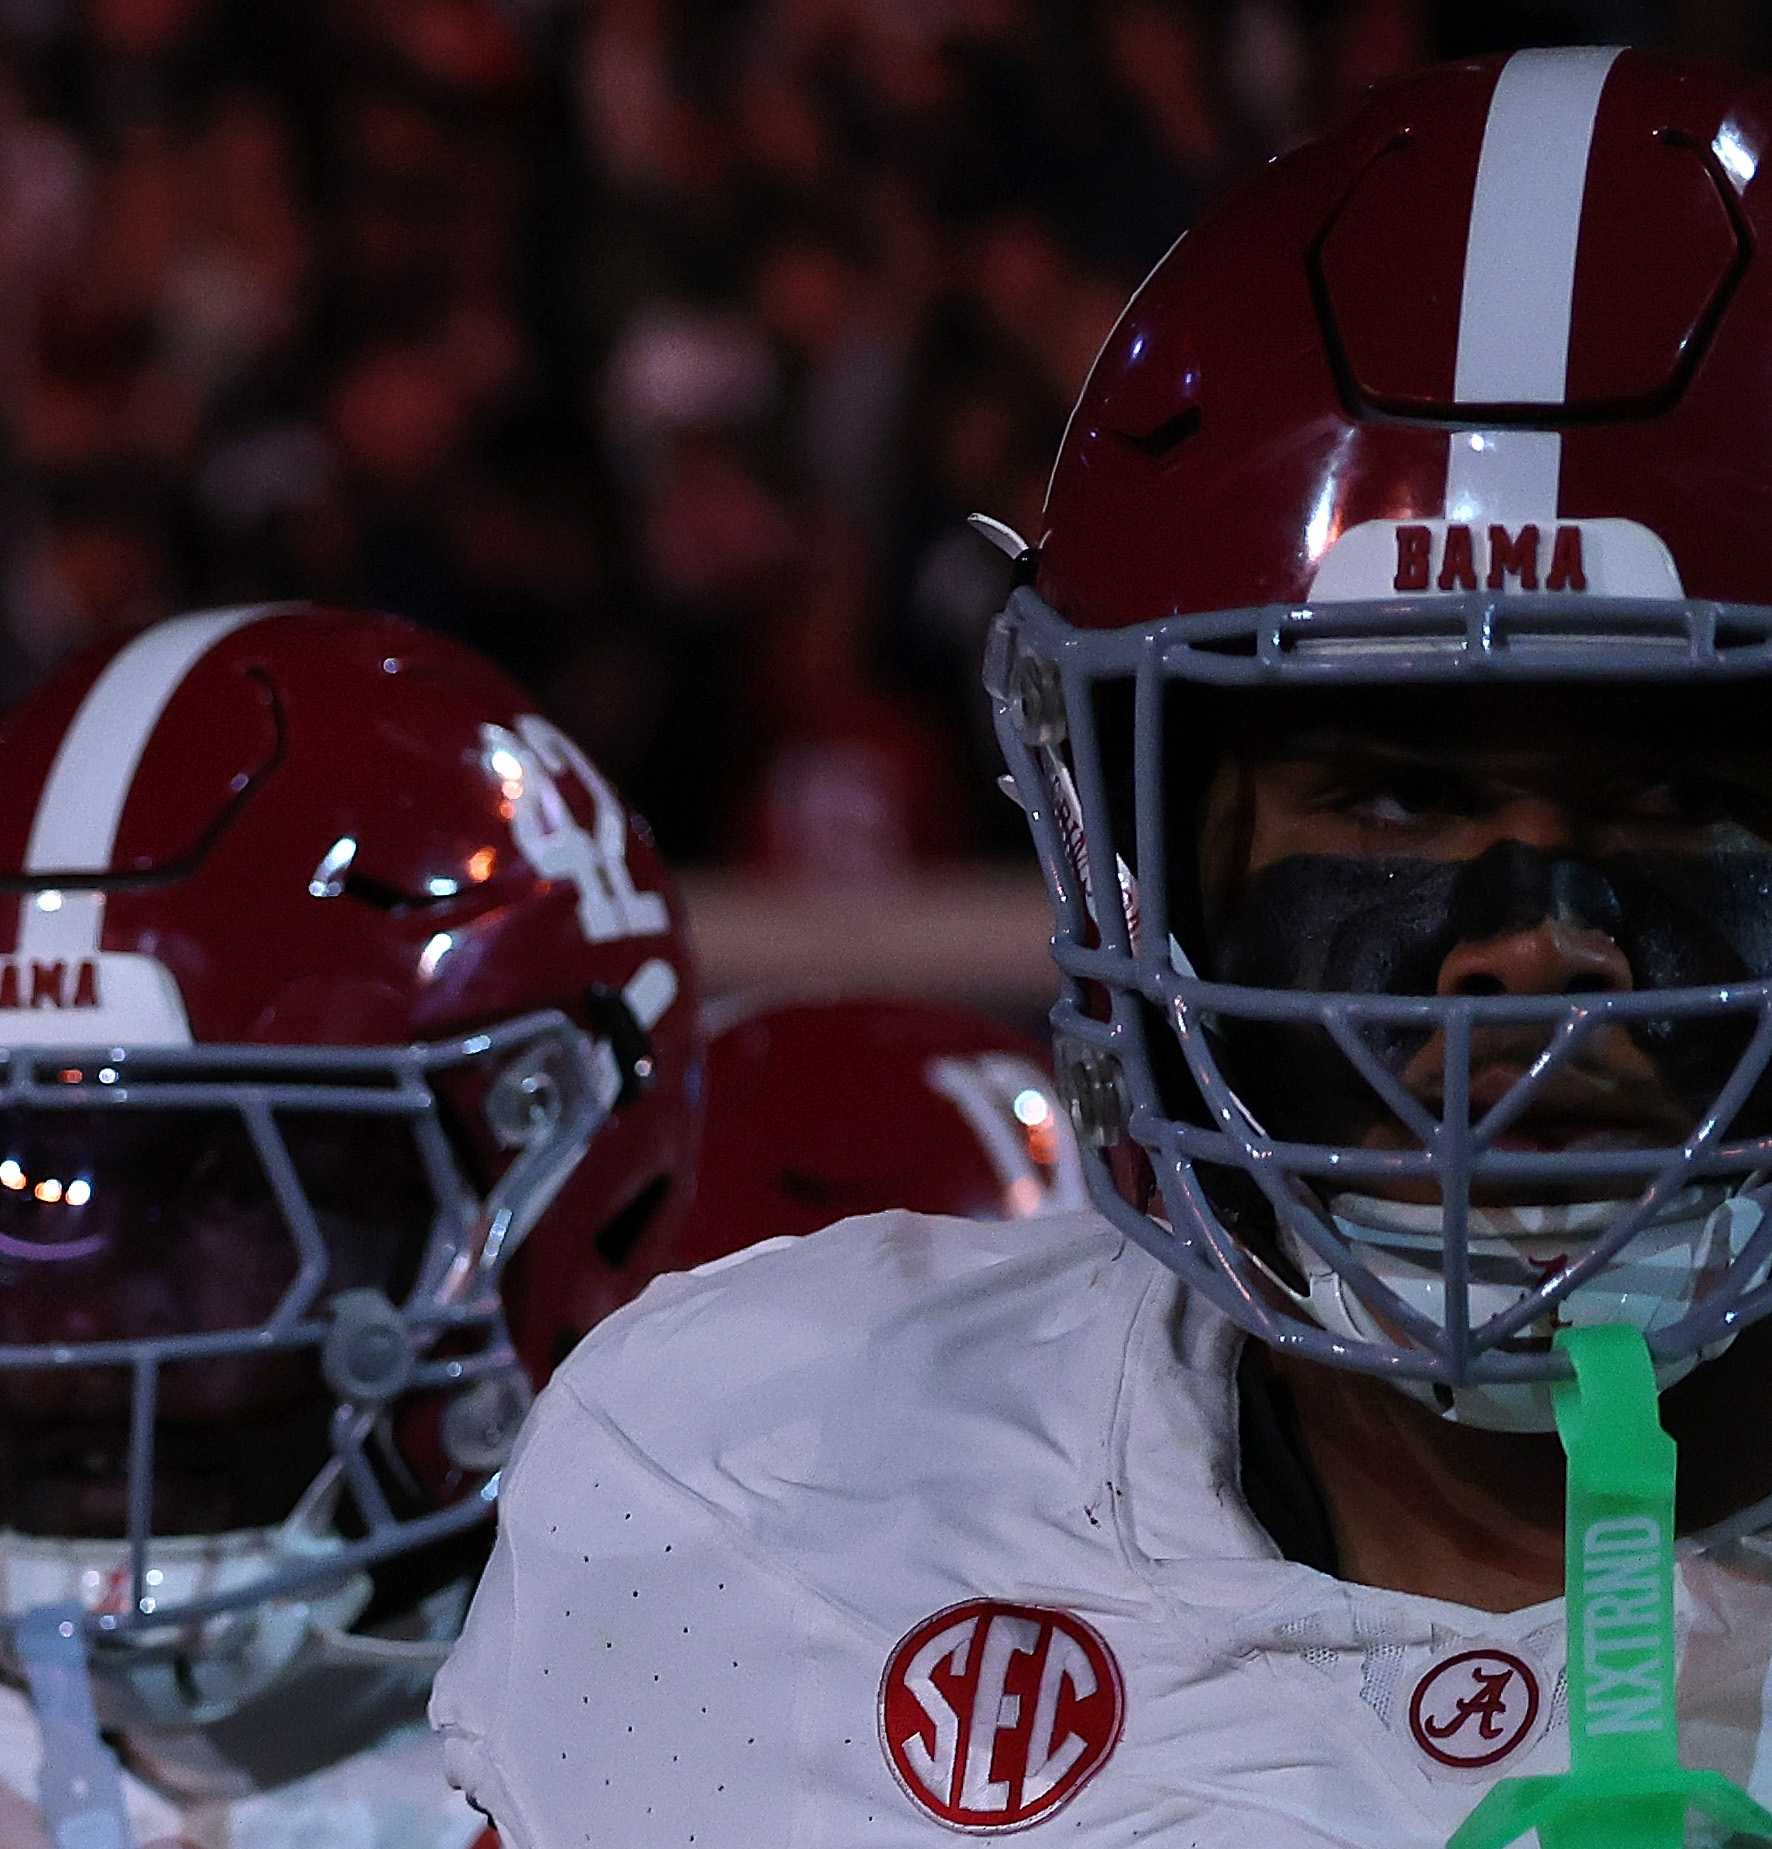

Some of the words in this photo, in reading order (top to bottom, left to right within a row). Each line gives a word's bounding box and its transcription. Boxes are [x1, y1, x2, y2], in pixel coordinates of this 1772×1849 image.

[1394, 524, 1588, 592] BAMA
[1583, 1513, 1664, 1738] NXTRND
[898, 1611, 1101, 1813] SEC
[1424, 1666, 1518, 1740] A
